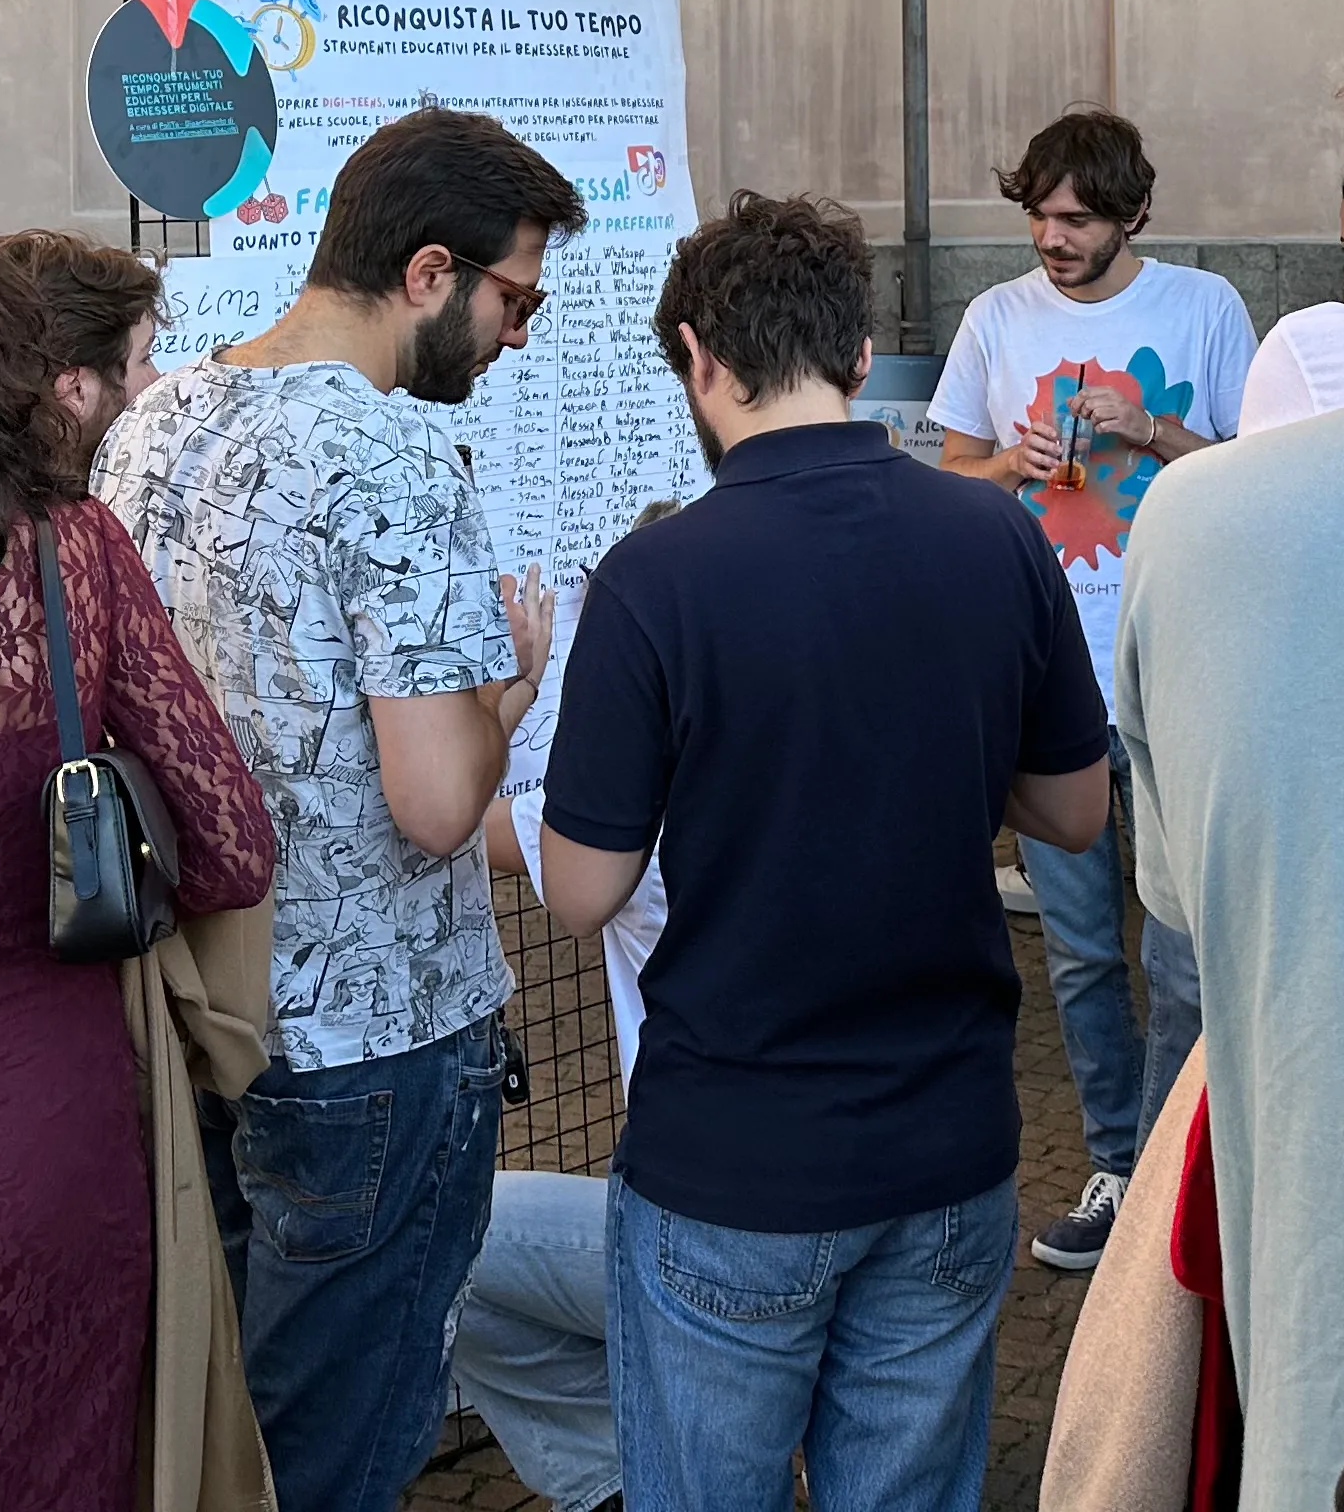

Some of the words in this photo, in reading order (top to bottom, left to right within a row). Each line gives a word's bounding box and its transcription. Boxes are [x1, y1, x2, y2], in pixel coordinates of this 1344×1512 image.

[338, 4, 493, 31] RICONQUISTA
[502, 9, 520, 30] IL
[527, 9, 567, 31] TUO
[575, 12, 642, 37] TEMPO
[324, 39, 396, 55] STRUMENTI
[402, 41, 468, 55] EDUCATIVI
[474, 43, 496, 55] PER
[501, 43, 511, 54] IL
[516, 43, 580, 57] BENESSERE
[583, 45, 629, 59] DIGITALE
[122, 71, 190, 85] RICONQUISTA
[192, 71, 201, 80] IL
[203, 69, 224, 80] TUO
[164, 80, 223, 93] STRUMENTI
[126, 94, 179, 107] EDUCATIVI
[181, 92, 201, 104] PER
[203, 92, 213, 101] IL
[277, 97, 318, 110] OPRIRE
[388, 98, 407, 108] UNA
[482, 97, 539, 108] INTERATTIVA
[542, 97, 559, 108] PER
[562, 97, 609, 108] INSEGNARE
[611, 98, 618, 107] IL
[621, 97, 665, 108] BENESSERE
[127, 103, 188, 118] BENESSERE
[189, 100, 234, 114] DIGITALE
[289, 116, 322, 130] NELLE
[327, 116, 372, 127] SCUOLE,
[375, 116, 381, 126] E
[510, 115, 529, 125] UNO
[532, 114, 585, 125] STRUMENTO
[588, 115, 605, 125] PER
[607, 114, 660, 125] PROGETTARE
[535, 131, 561, 142] DEGLI
[233, 231, 302, 251] QUANTO
[606, 213, 674, 233] PREFERITA?
[589, 331, 596, 344] R
[562, 364, 605, 380] Riccardo
[608, 362, 615, 378] G
[614, 446, 659, 464] Instagram
[555, 534, 592, 552] Roberta
[595, 534, 601, 547] B
[554, 572, 584, 588] Allegra
[1069, 582, 1121, 596] NIGHT
[500, 778, 544, 798] ELITE.P
